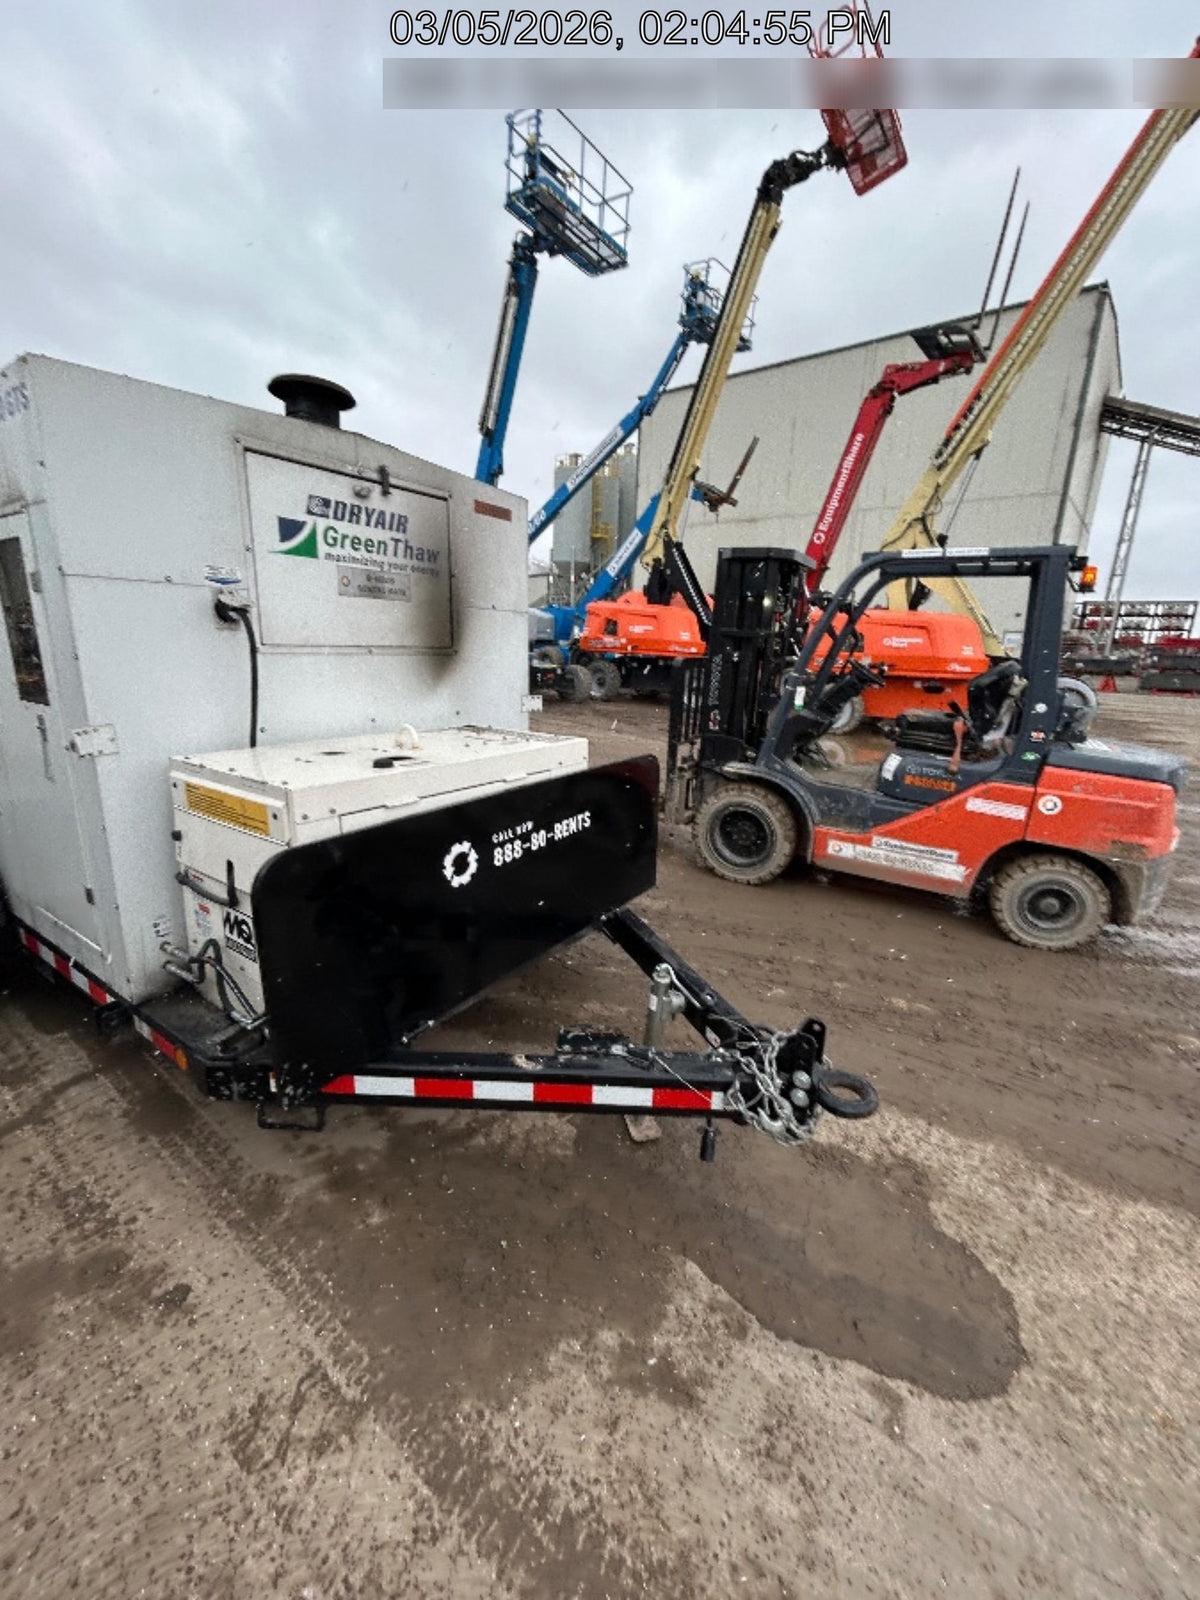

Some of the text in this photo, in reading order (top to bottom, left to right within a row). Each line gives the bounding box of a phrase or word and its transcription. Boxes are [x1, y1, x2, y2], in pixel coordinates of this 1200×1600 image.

[818, 433, 865, 532] EquipmentShare
[332, 500, 410, 534] DRYAIR
[324, 552, 440, 578] maximizing your energy
[492, 828, 515, 844] CALL
[493, 810, 592, 866] 888-80-RENTS
[224, 911, 256, 949] MQ
